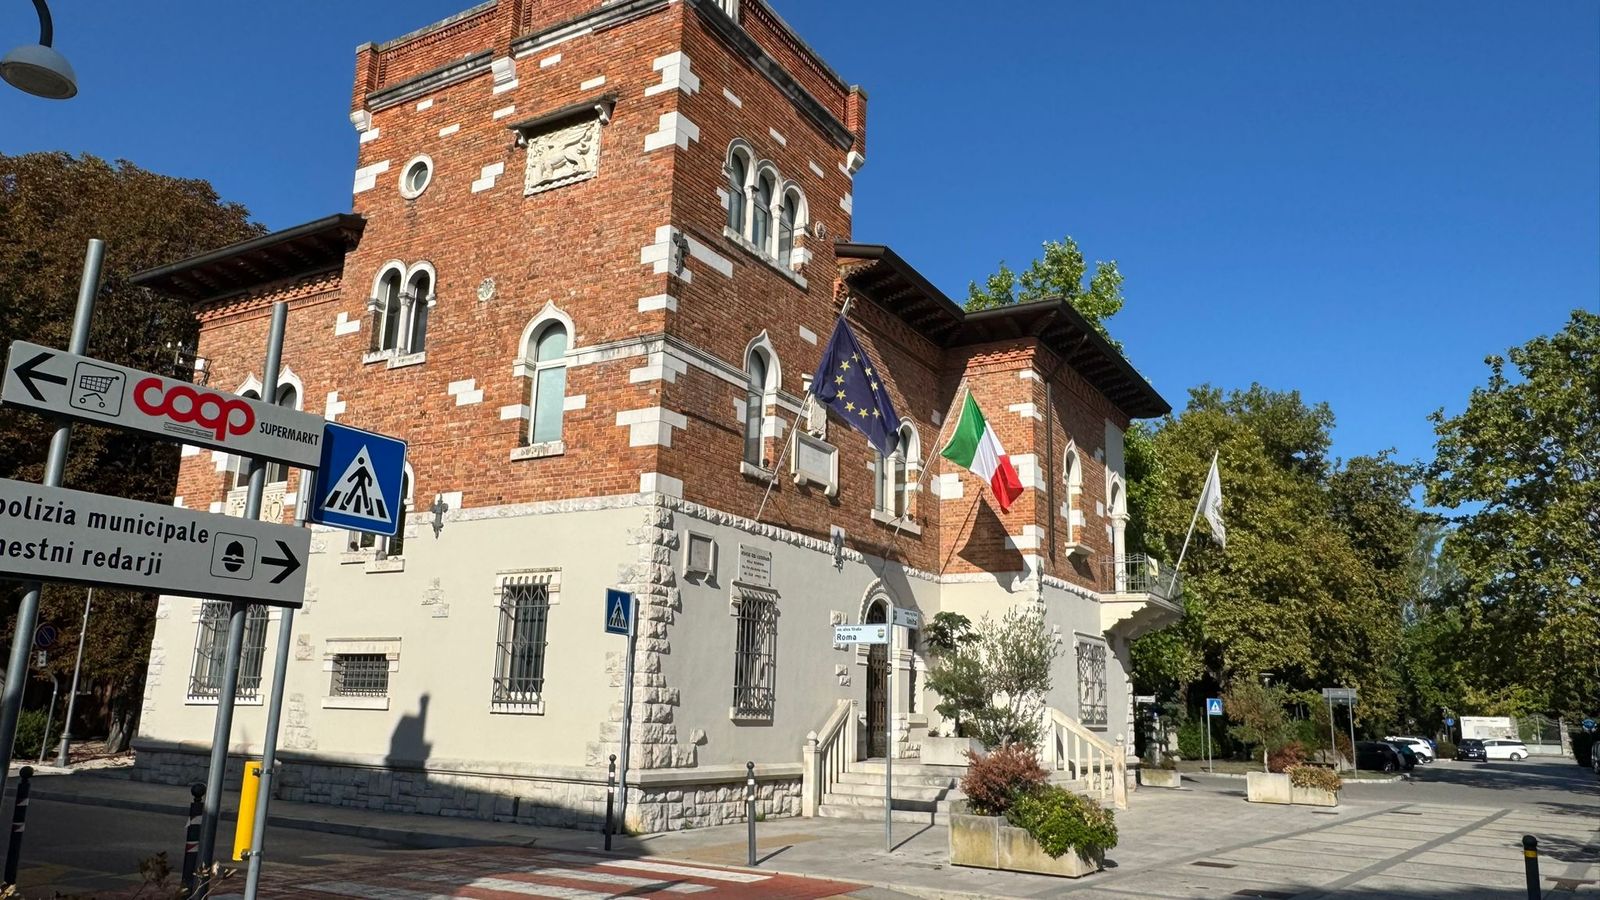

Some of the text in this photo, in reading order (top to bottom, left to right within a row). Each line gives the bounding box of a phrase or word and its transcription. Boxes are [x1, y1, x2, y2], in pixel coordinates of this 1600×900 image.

[133, 377, 255, 442] coop
[259, 421, 320, 446] SUPERMARKT
[87, 511, 209, 544] municipale
[0, 538, 163, 576] estni redarji
[836, 633, 857, 641] Roma
